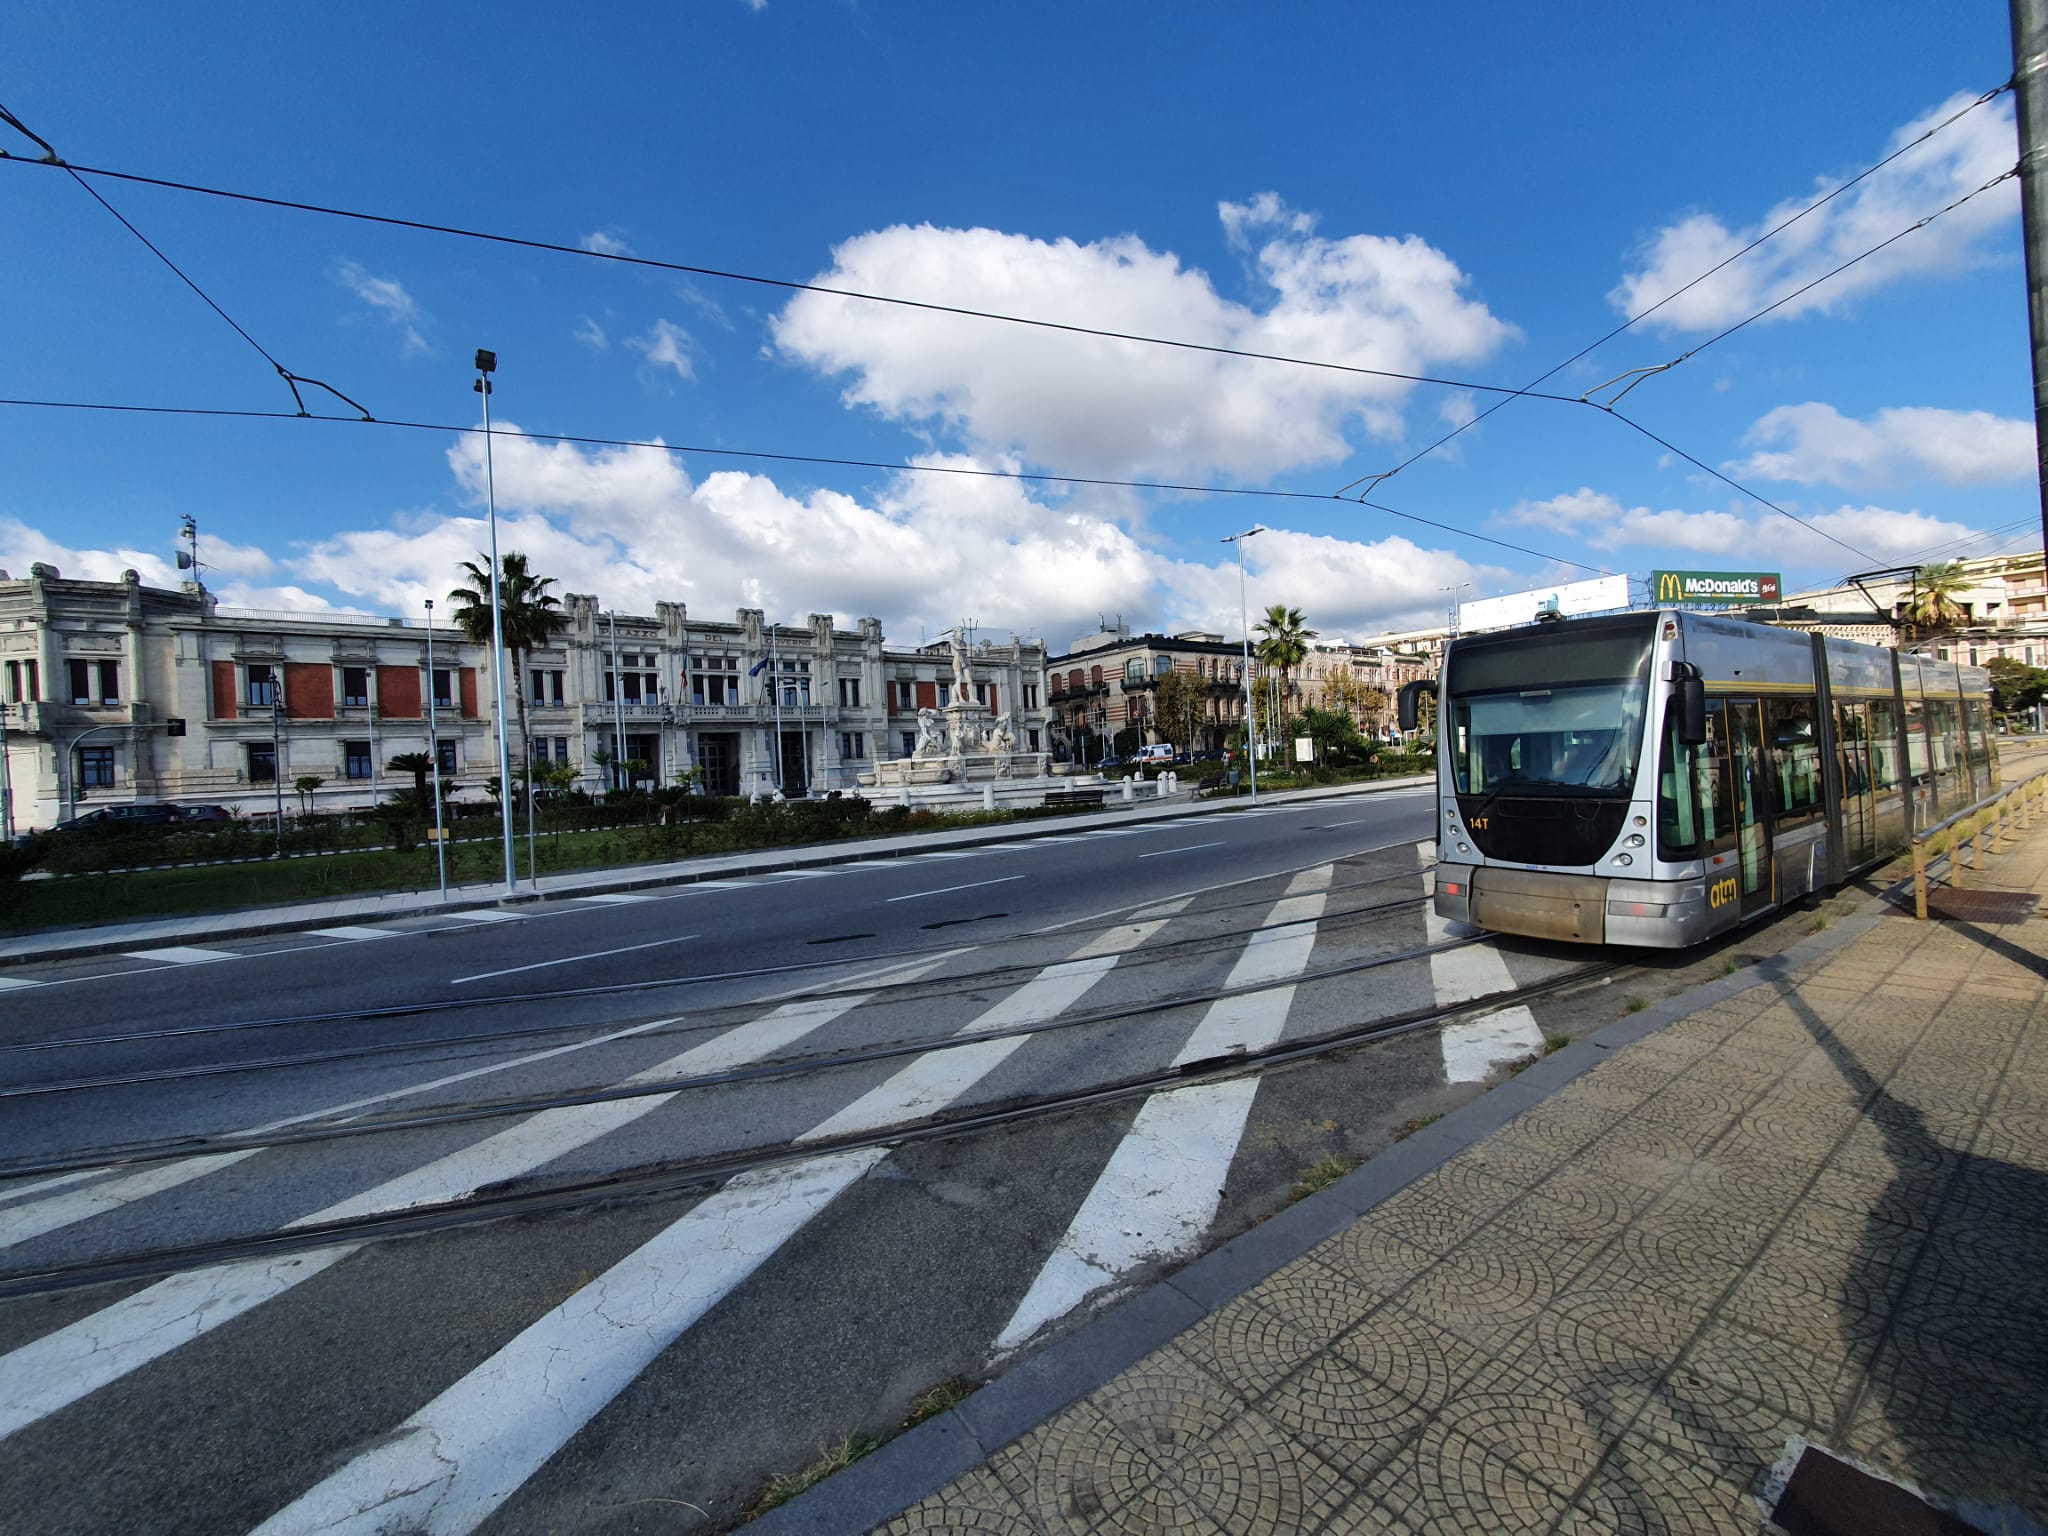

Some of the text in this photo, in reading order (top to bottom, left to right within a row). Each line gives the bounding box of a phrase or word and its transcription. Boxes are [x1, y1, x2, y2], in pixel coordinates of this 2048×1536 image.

[1685, 578, 1759, 593] McDonald's
[704, 634, 724, 642] DEL
[1470, 817, 1489, 830] 14T
[1711, 878, 1737, 909] atm
